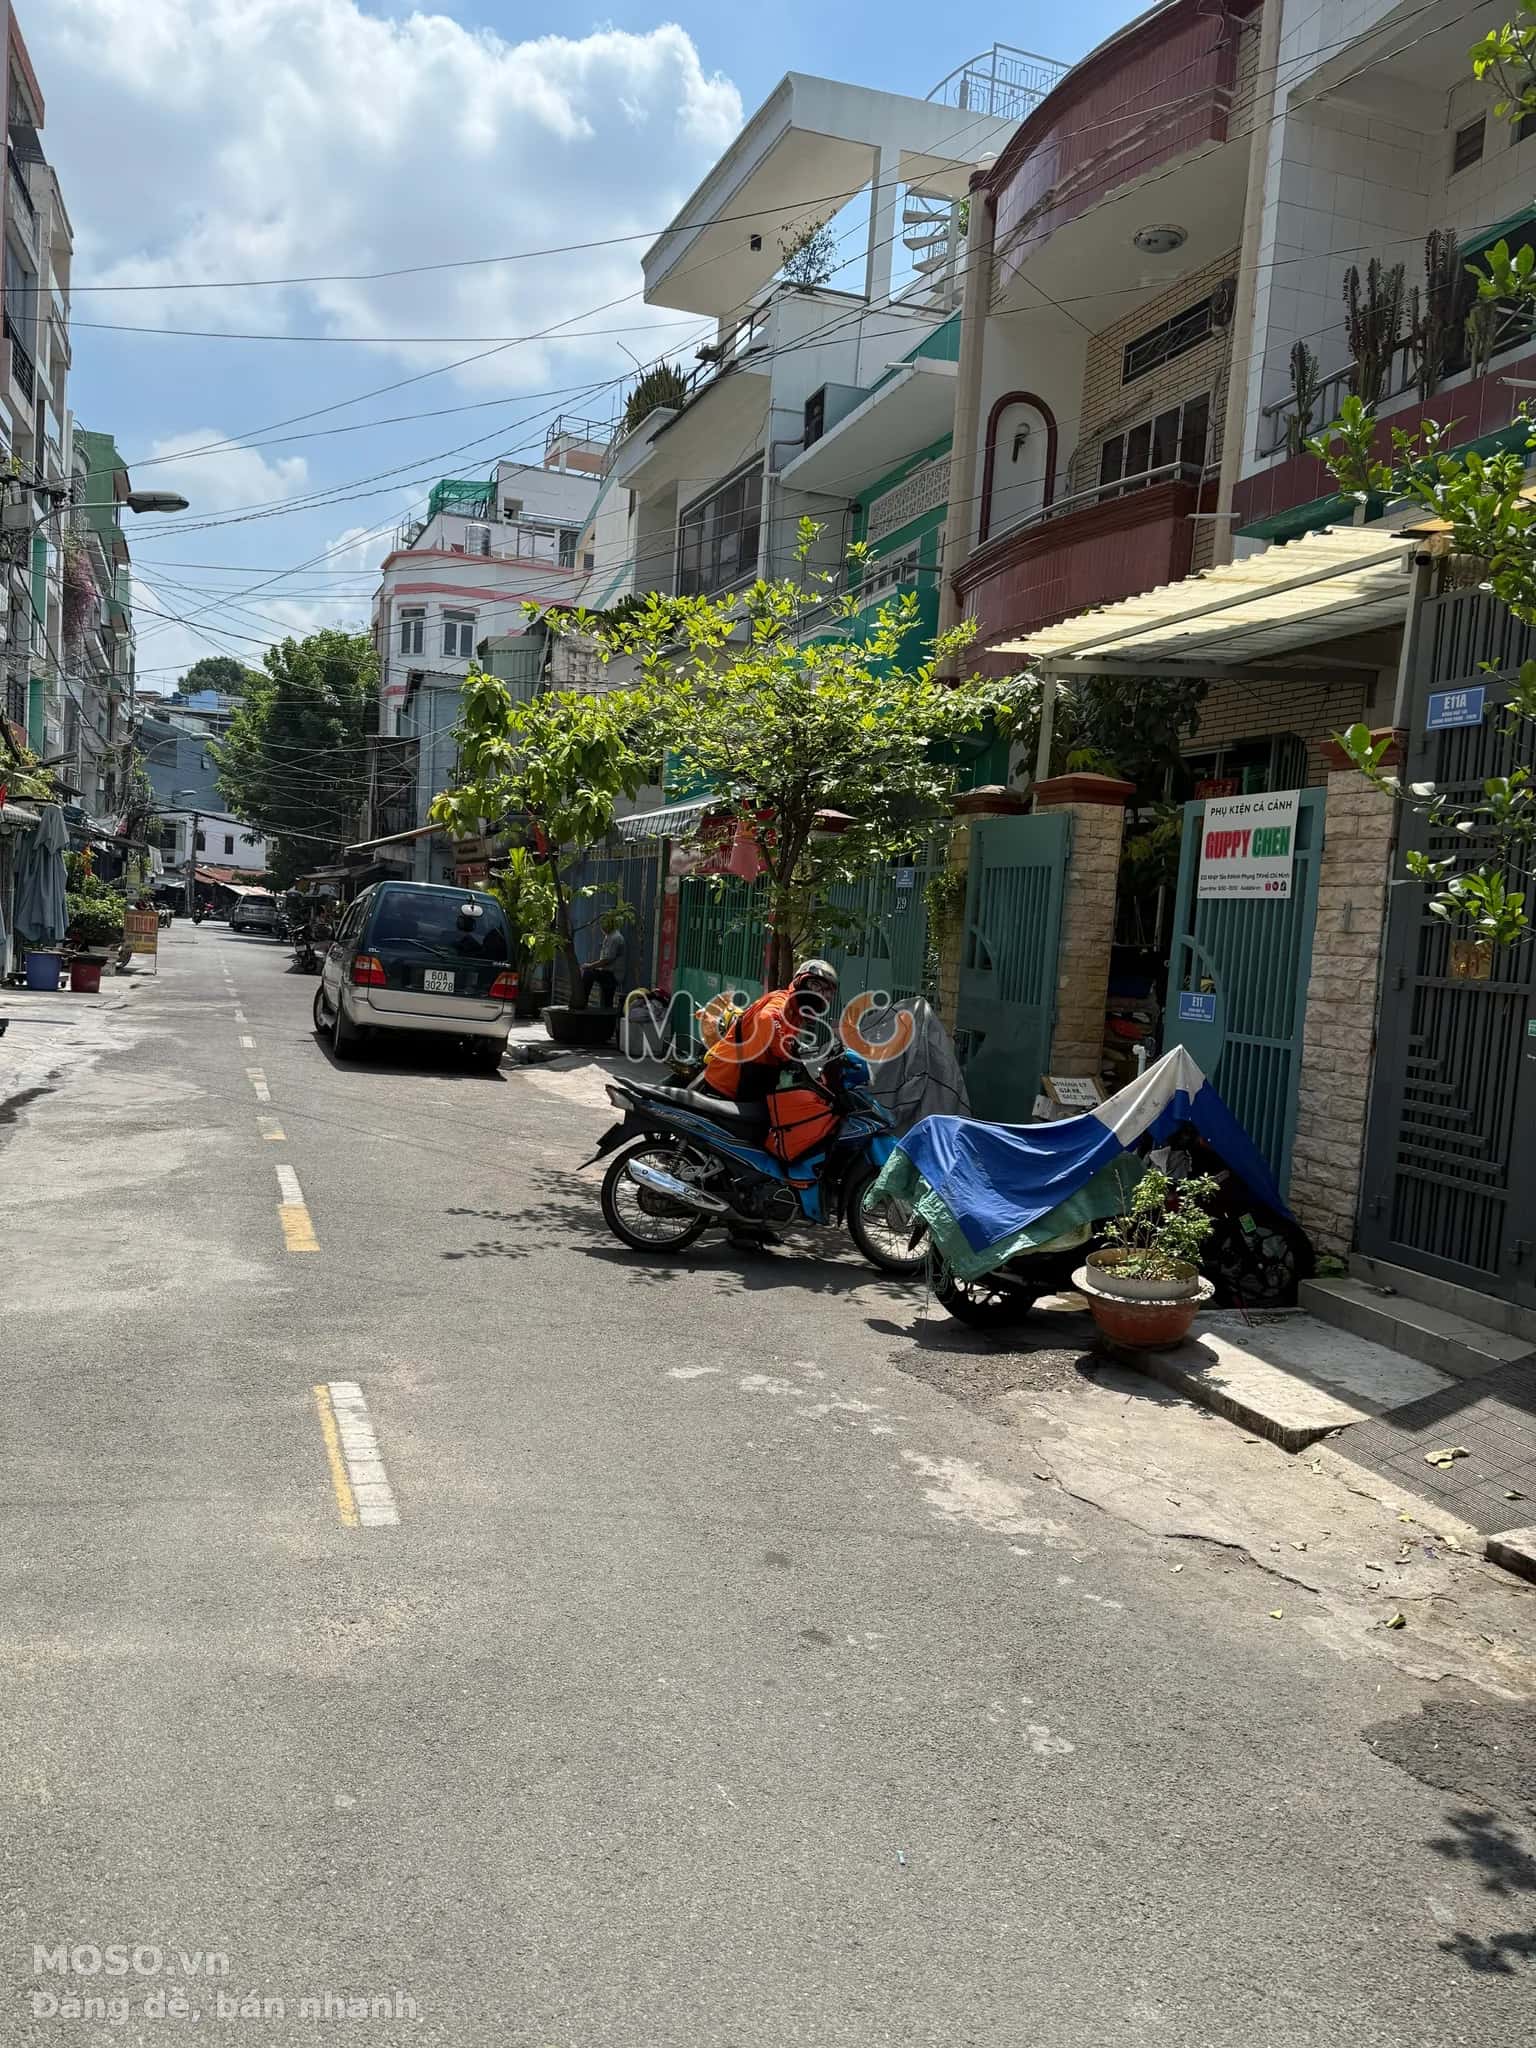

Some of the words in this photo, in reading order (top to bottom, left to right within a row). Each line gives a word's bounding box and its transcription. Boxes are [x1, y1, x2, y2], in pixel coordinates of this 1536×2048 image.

[1444, 693, 1467, 710] E11A
[1210, 808, 1228, 818] PHỤ
[1229, 803, 1251, 816] KIỆN
[1253, 801, 1265, 812] CÁ
[1267, 798, 1293, 811] CẢNH
[1206, 829, 1251, 860] GUPPY
[1252, 826, 1291, 858] CHEN
[431, 971, 448, 982] 60A
[425, 980, 454, 992] 30278
[1192, 996, 1203, 1007] E11
